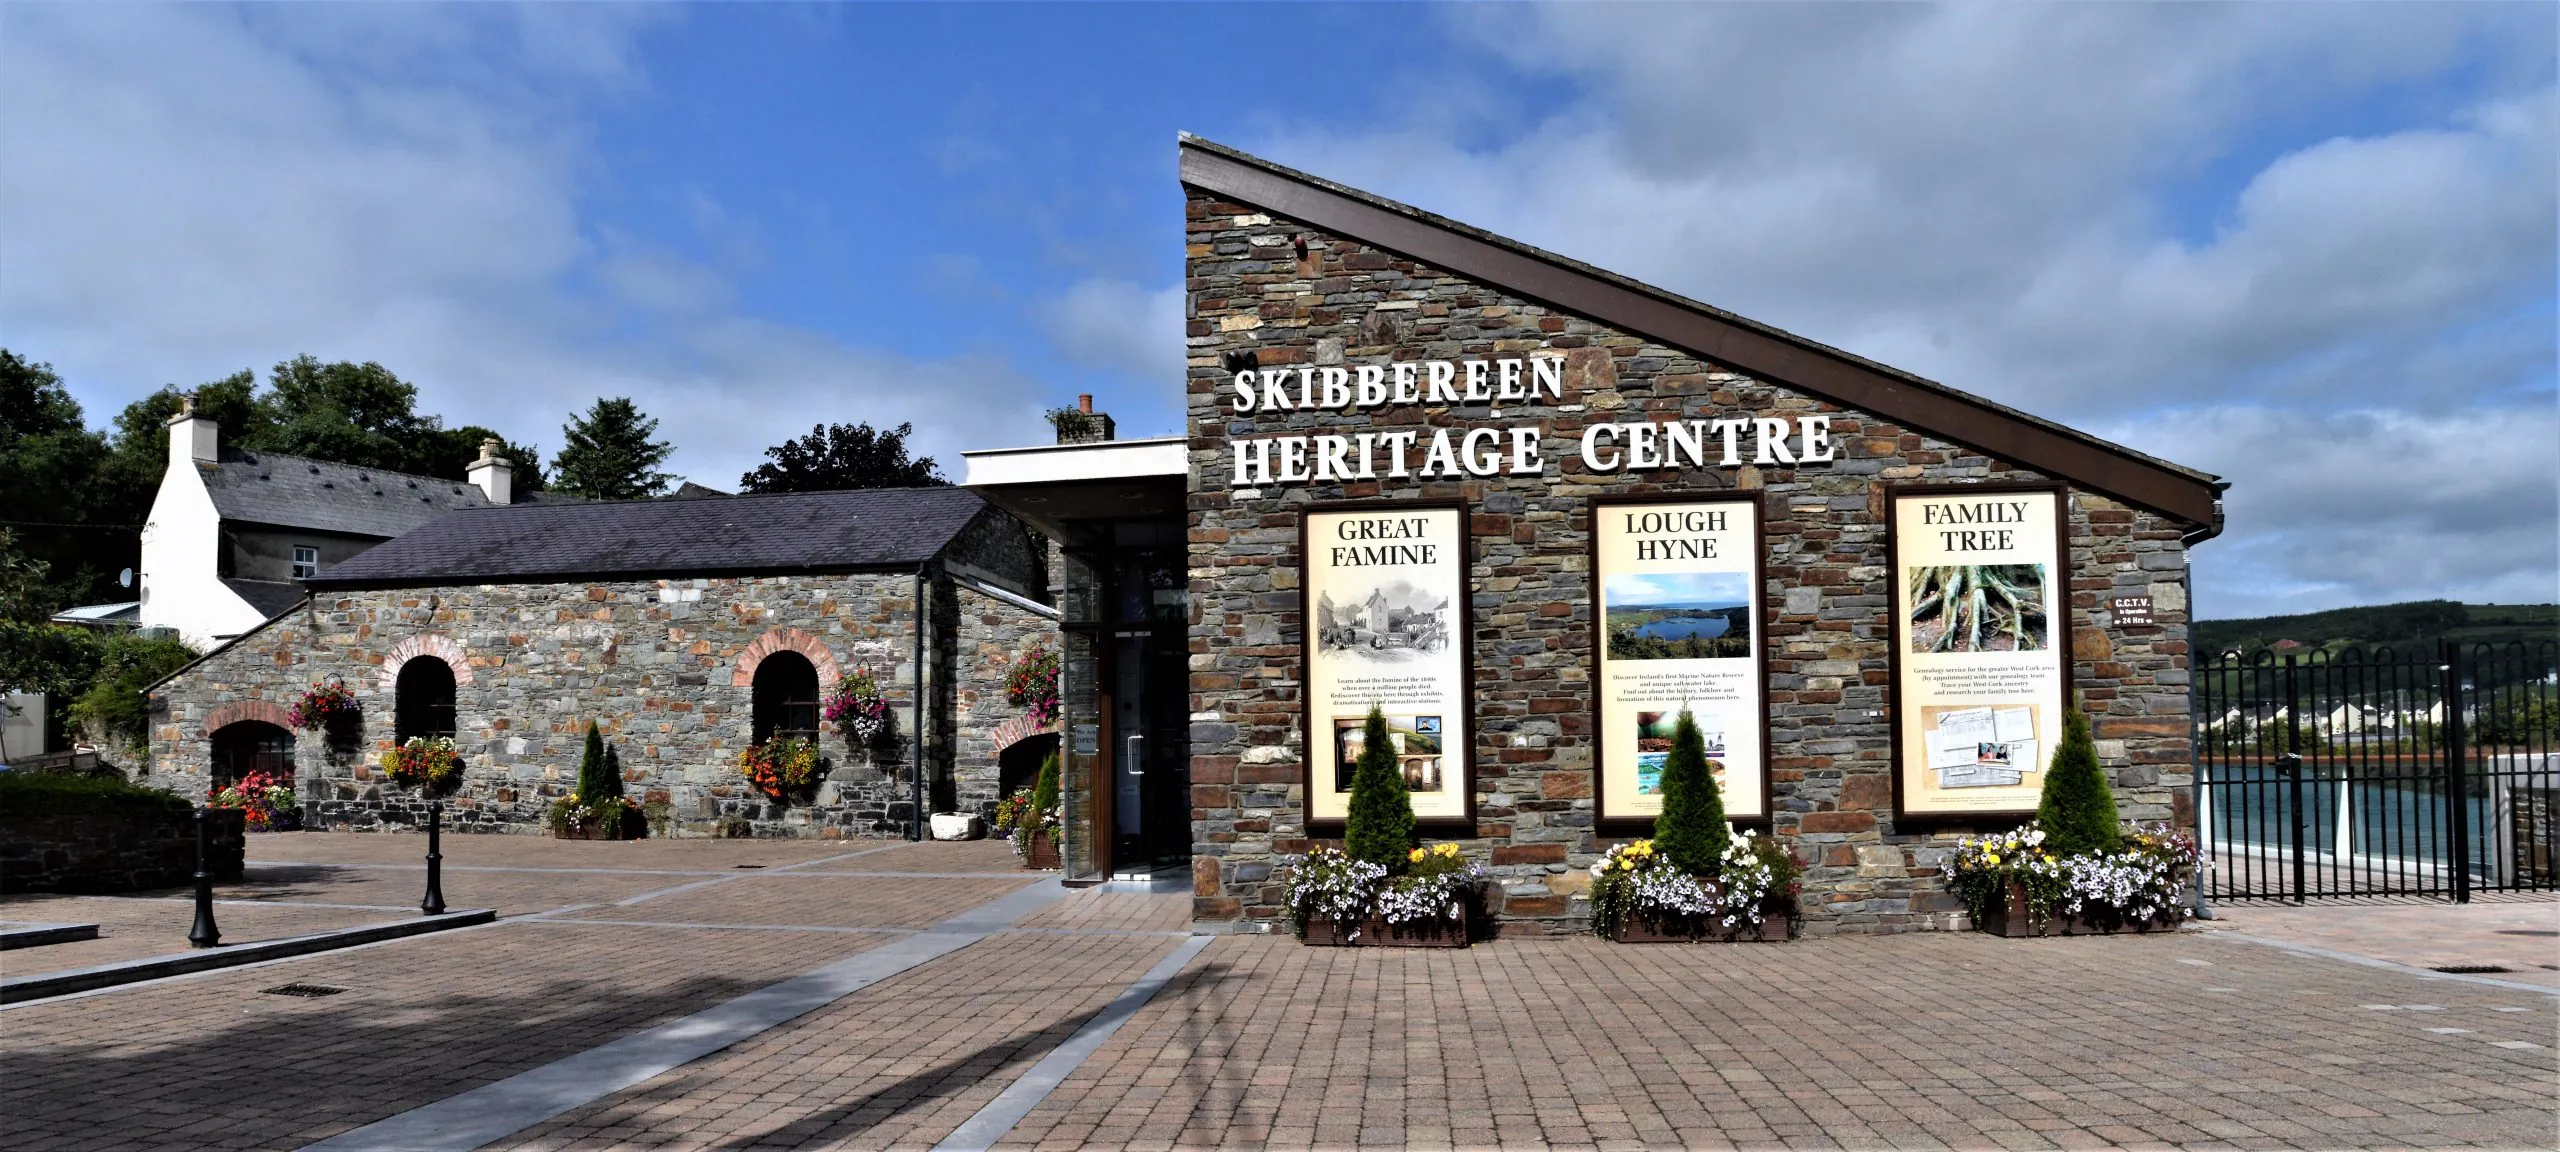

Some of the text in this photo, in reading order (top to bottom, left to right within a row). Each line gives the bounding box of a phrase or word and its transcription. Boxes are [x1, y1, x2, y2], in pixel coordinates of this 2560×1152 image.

[1233, 357, 1564, 412] SKIBBEREEN
[1230, 416, 1835, 485] HERITAGE CENTRE
[1625, 511, 1727, 533] LOUGH
[1923, 502, 2028, 524] FAMILY
[1338, 518, 1429, 541] GREAT
[1940, 530, 2014, 551] TREE
[1330, 544, 1437, 567] FAMINE
[1637, 538, 1717, 560] HYNE
[2115, 598, 2151, 608] C.C.T.V.
[2122, 616, 2145, 625] 24 Hrs
[1398, 683, 1417, 691] people
[1076, 736, 1096, 744] OPEN
